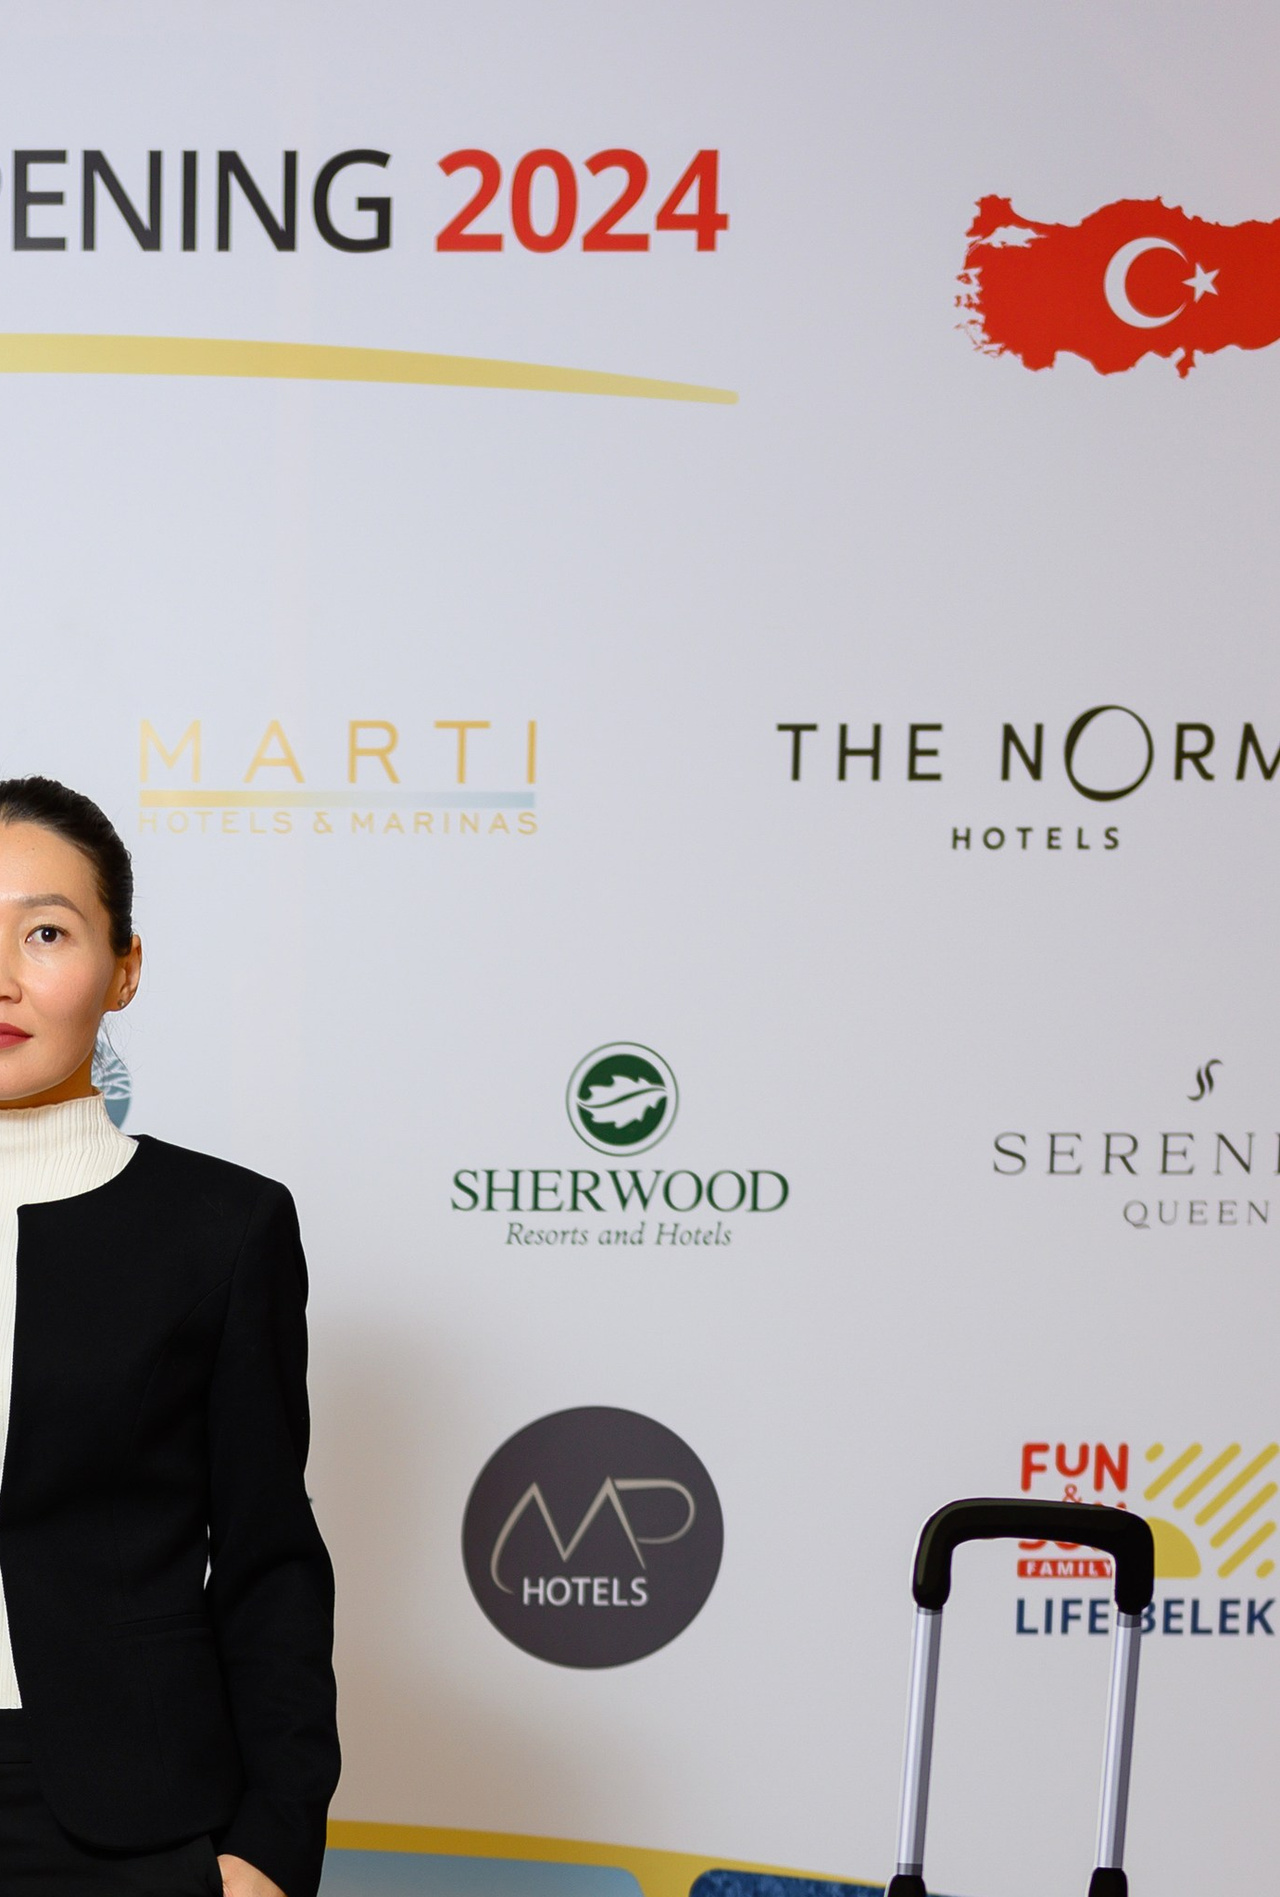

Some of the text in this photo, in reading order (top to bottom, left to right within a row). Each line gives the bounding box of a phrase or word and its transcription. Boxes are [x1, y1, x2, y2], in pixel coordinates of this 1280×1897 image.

[433, 148, 730, 254] 2024
[138, 719, 537, 785] MARTI
[776, 704, 1280, 802] THE NORM
[137, 810, 539, 836] HOTELS & MARINAS
[951, 826, 1120, 851] HOTELS
[451, 1168, 790, 1213] SHERWOOD
[503, 1221, 733, 1247] Resorts and Hotels
[1122, 1199, 1270, 1230] QUEEN
[1020, 1441, 1130, 1493] FUN
[522, 1575, 649, 1607] HOTELS
[1015, 1597, 1110, 1636] LIFE
